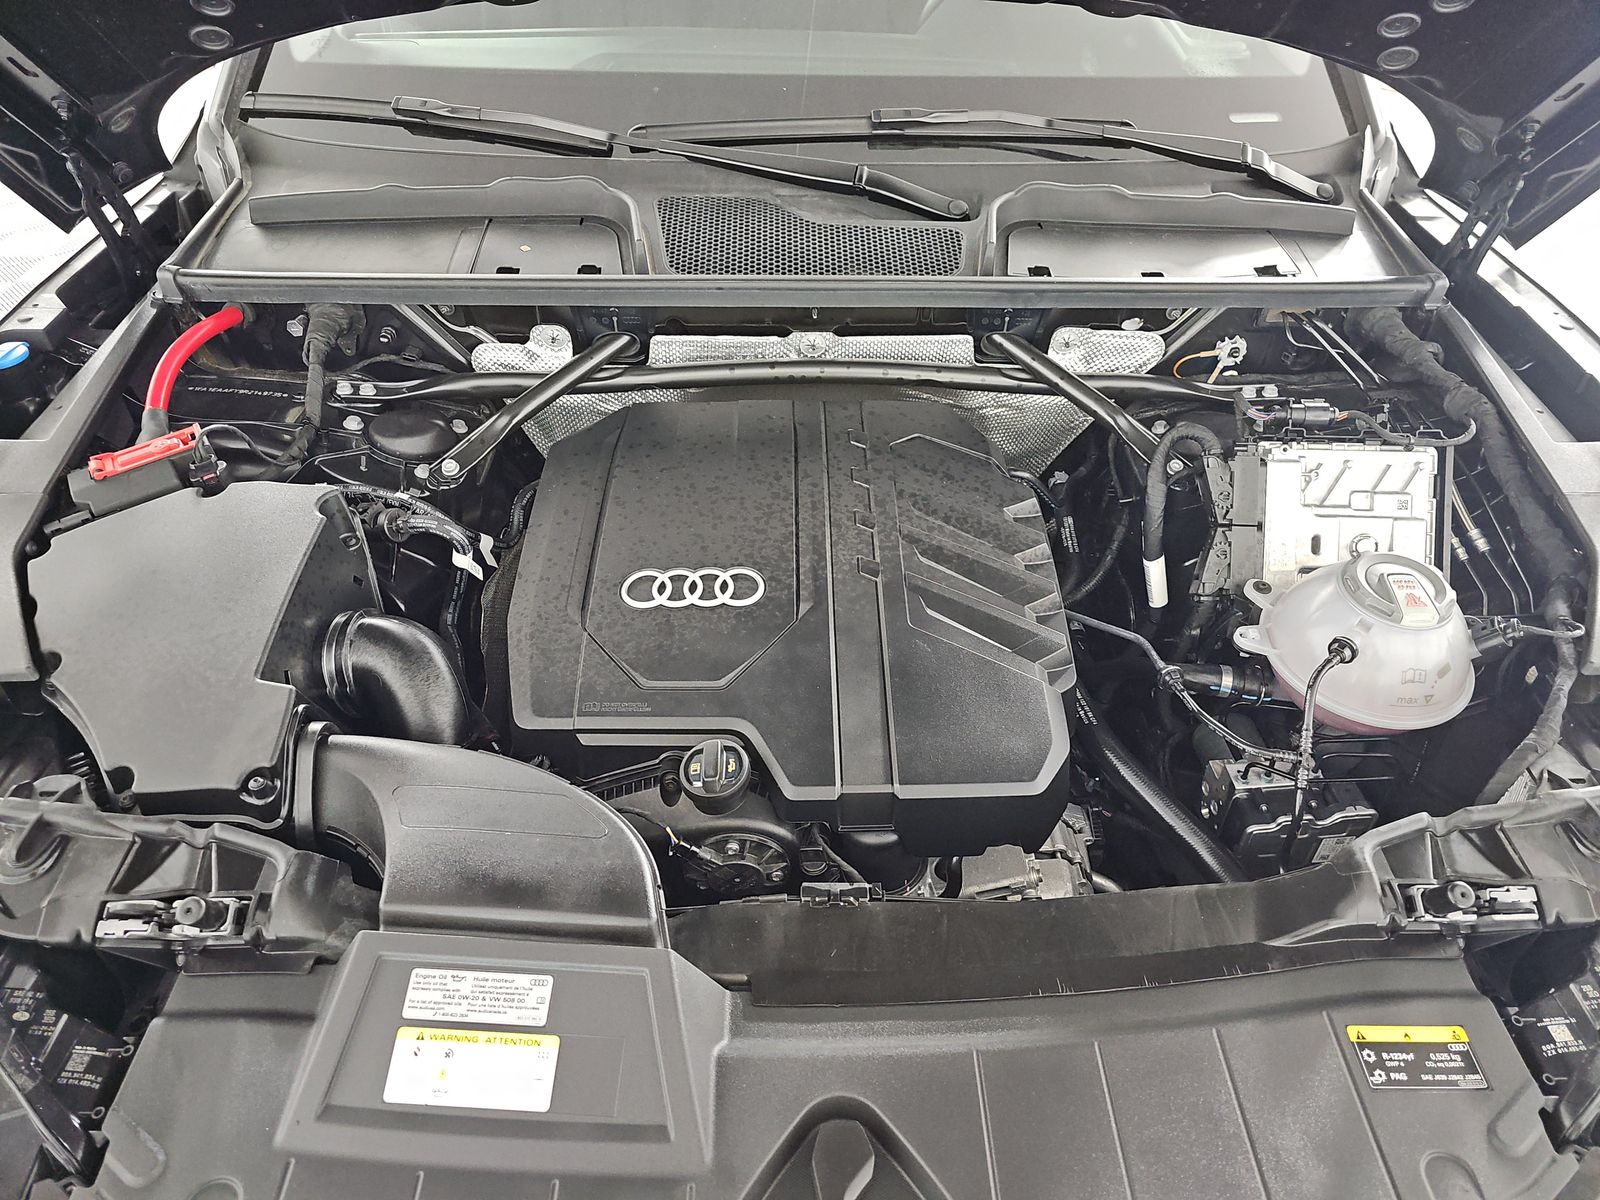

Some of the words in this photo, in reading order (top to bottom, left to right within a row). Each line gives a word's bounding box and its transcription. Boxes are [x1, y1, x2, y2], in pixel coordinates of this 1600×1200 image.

[1396, 697, 1419, 705] max
[429, 1034, 479, 1043] WARNING
[485, 1037, 541, 1047] ATTENTION
[1450, 1053, 1462, 1061] kg
[1389, 1072, 1408, 1080] PAG
